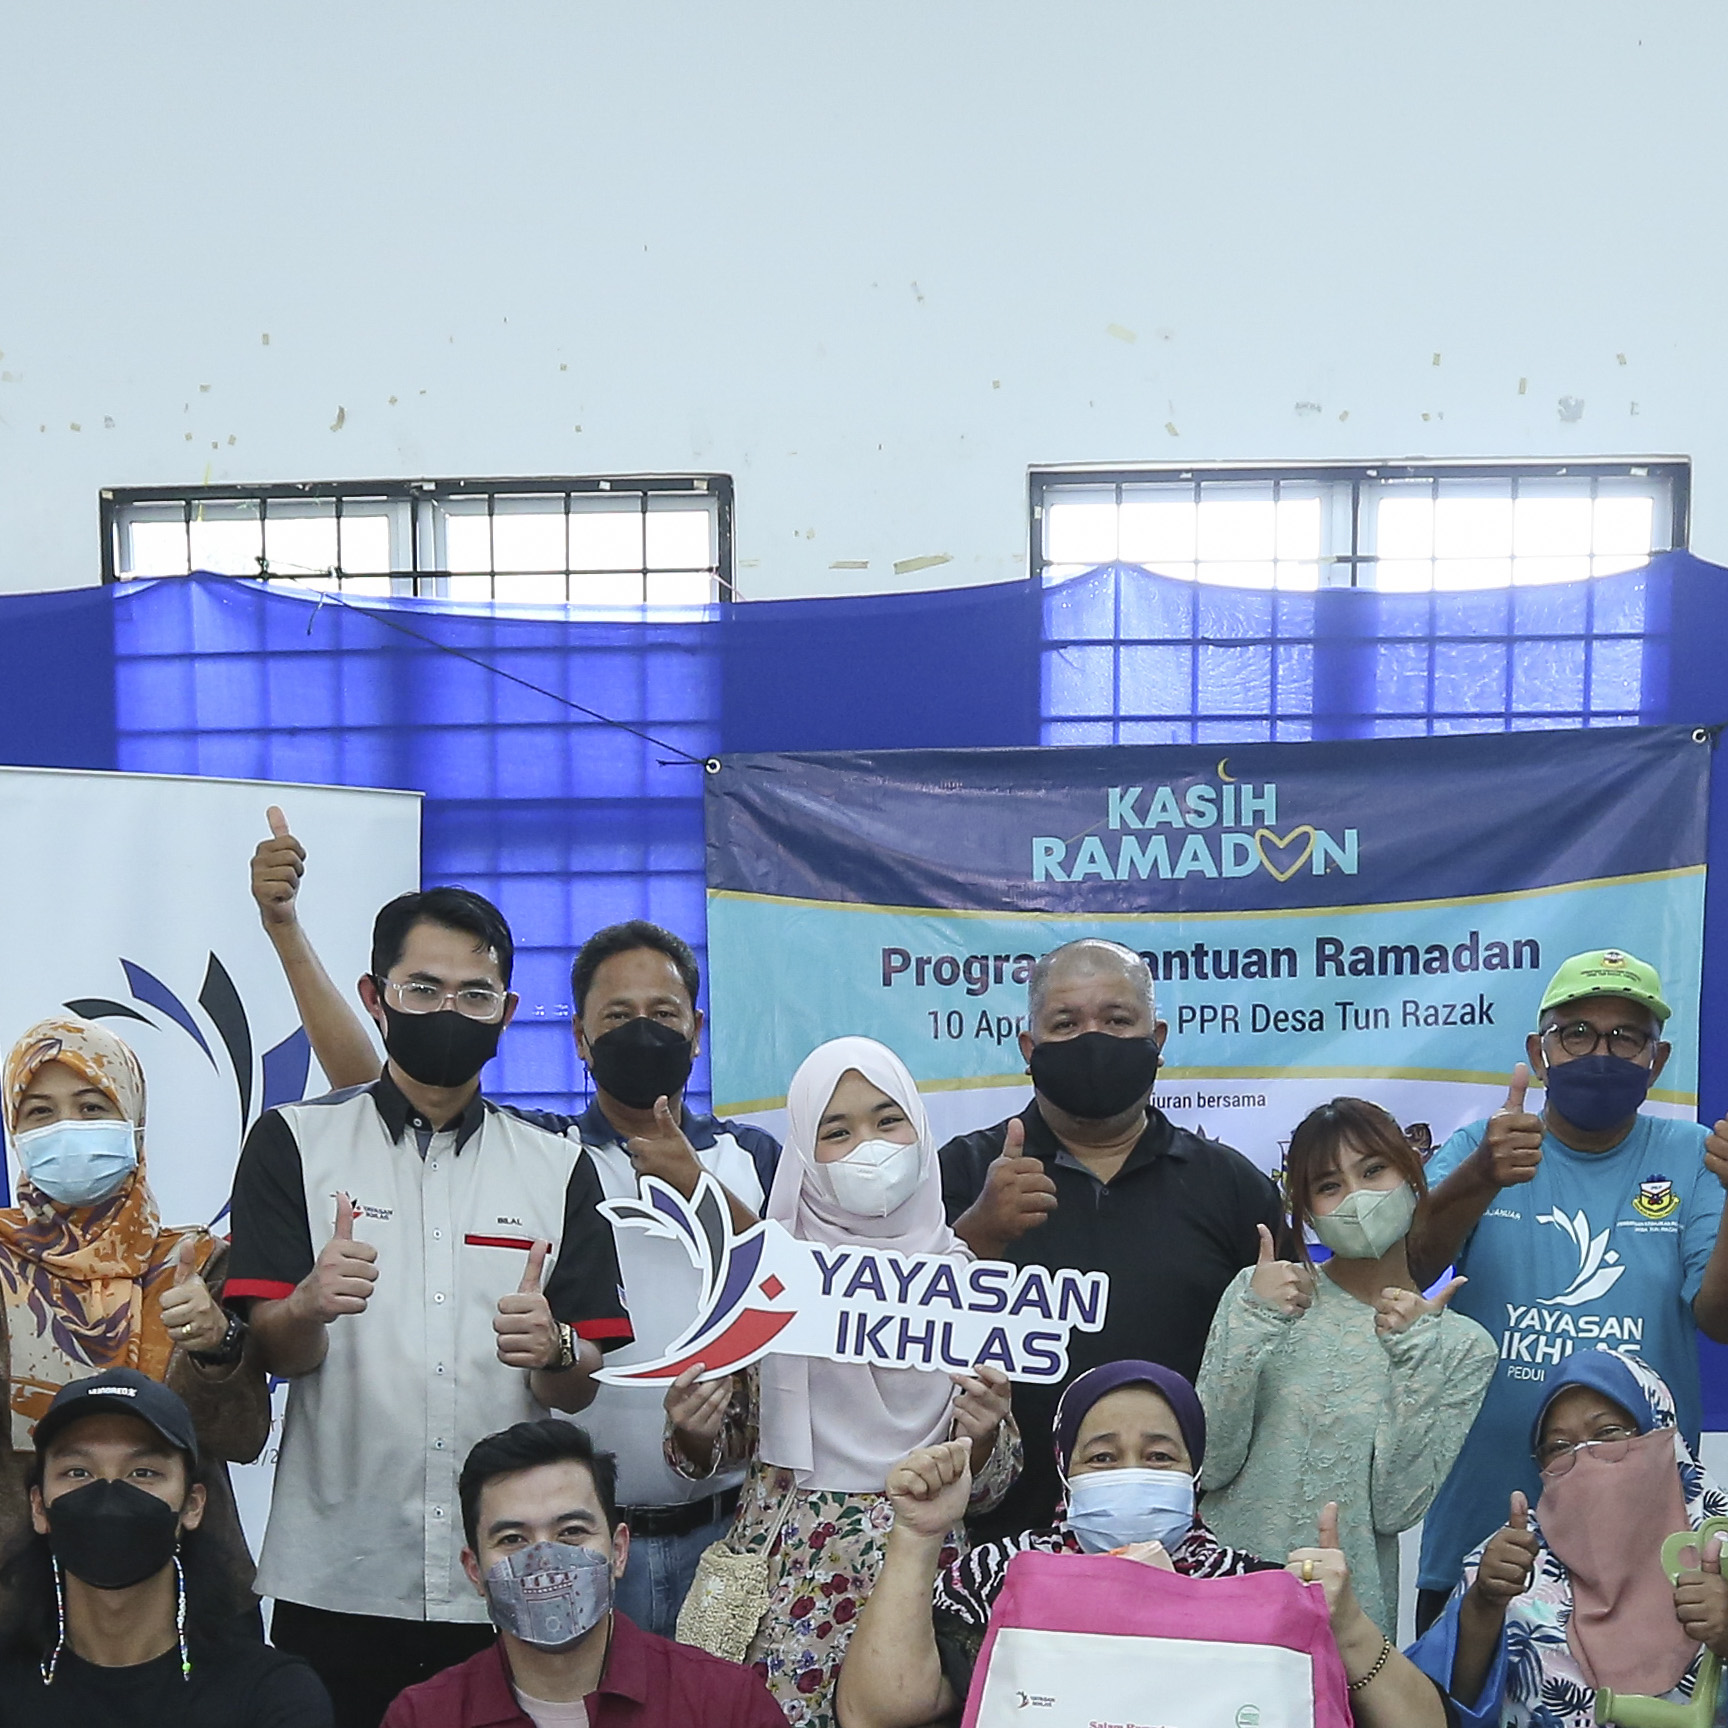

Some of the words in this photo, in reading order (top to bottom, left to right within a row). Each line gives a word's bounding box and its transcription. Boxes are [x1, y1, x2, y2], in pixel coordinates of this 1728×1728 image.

[1108, 783, 1277, 830] KASIH
[881, 947, 1049, 997] Progra
[1138, 942, 1298, 981] antuan
[1315, 930, 1540, 978] Ramadan
[928, 1009, 964, 1040] 10
[974, 1009, 1025, 1046] Apr
[1178, 1004, 1240, 1035] PPR
[1251, 1003, 1324, 1033] Desa
[1335, 1001, 1390, 1031] Tun
[1402, 993, 1495, 1028] Razak
[1197, 1092, 1267, 1109] bersama
[812, 1248, 1103, 1325] YAYASAN
[835, 1310, 1065, 1375] IKHLAS
[1505, 1303, 1644, 1341] YAYASAN
